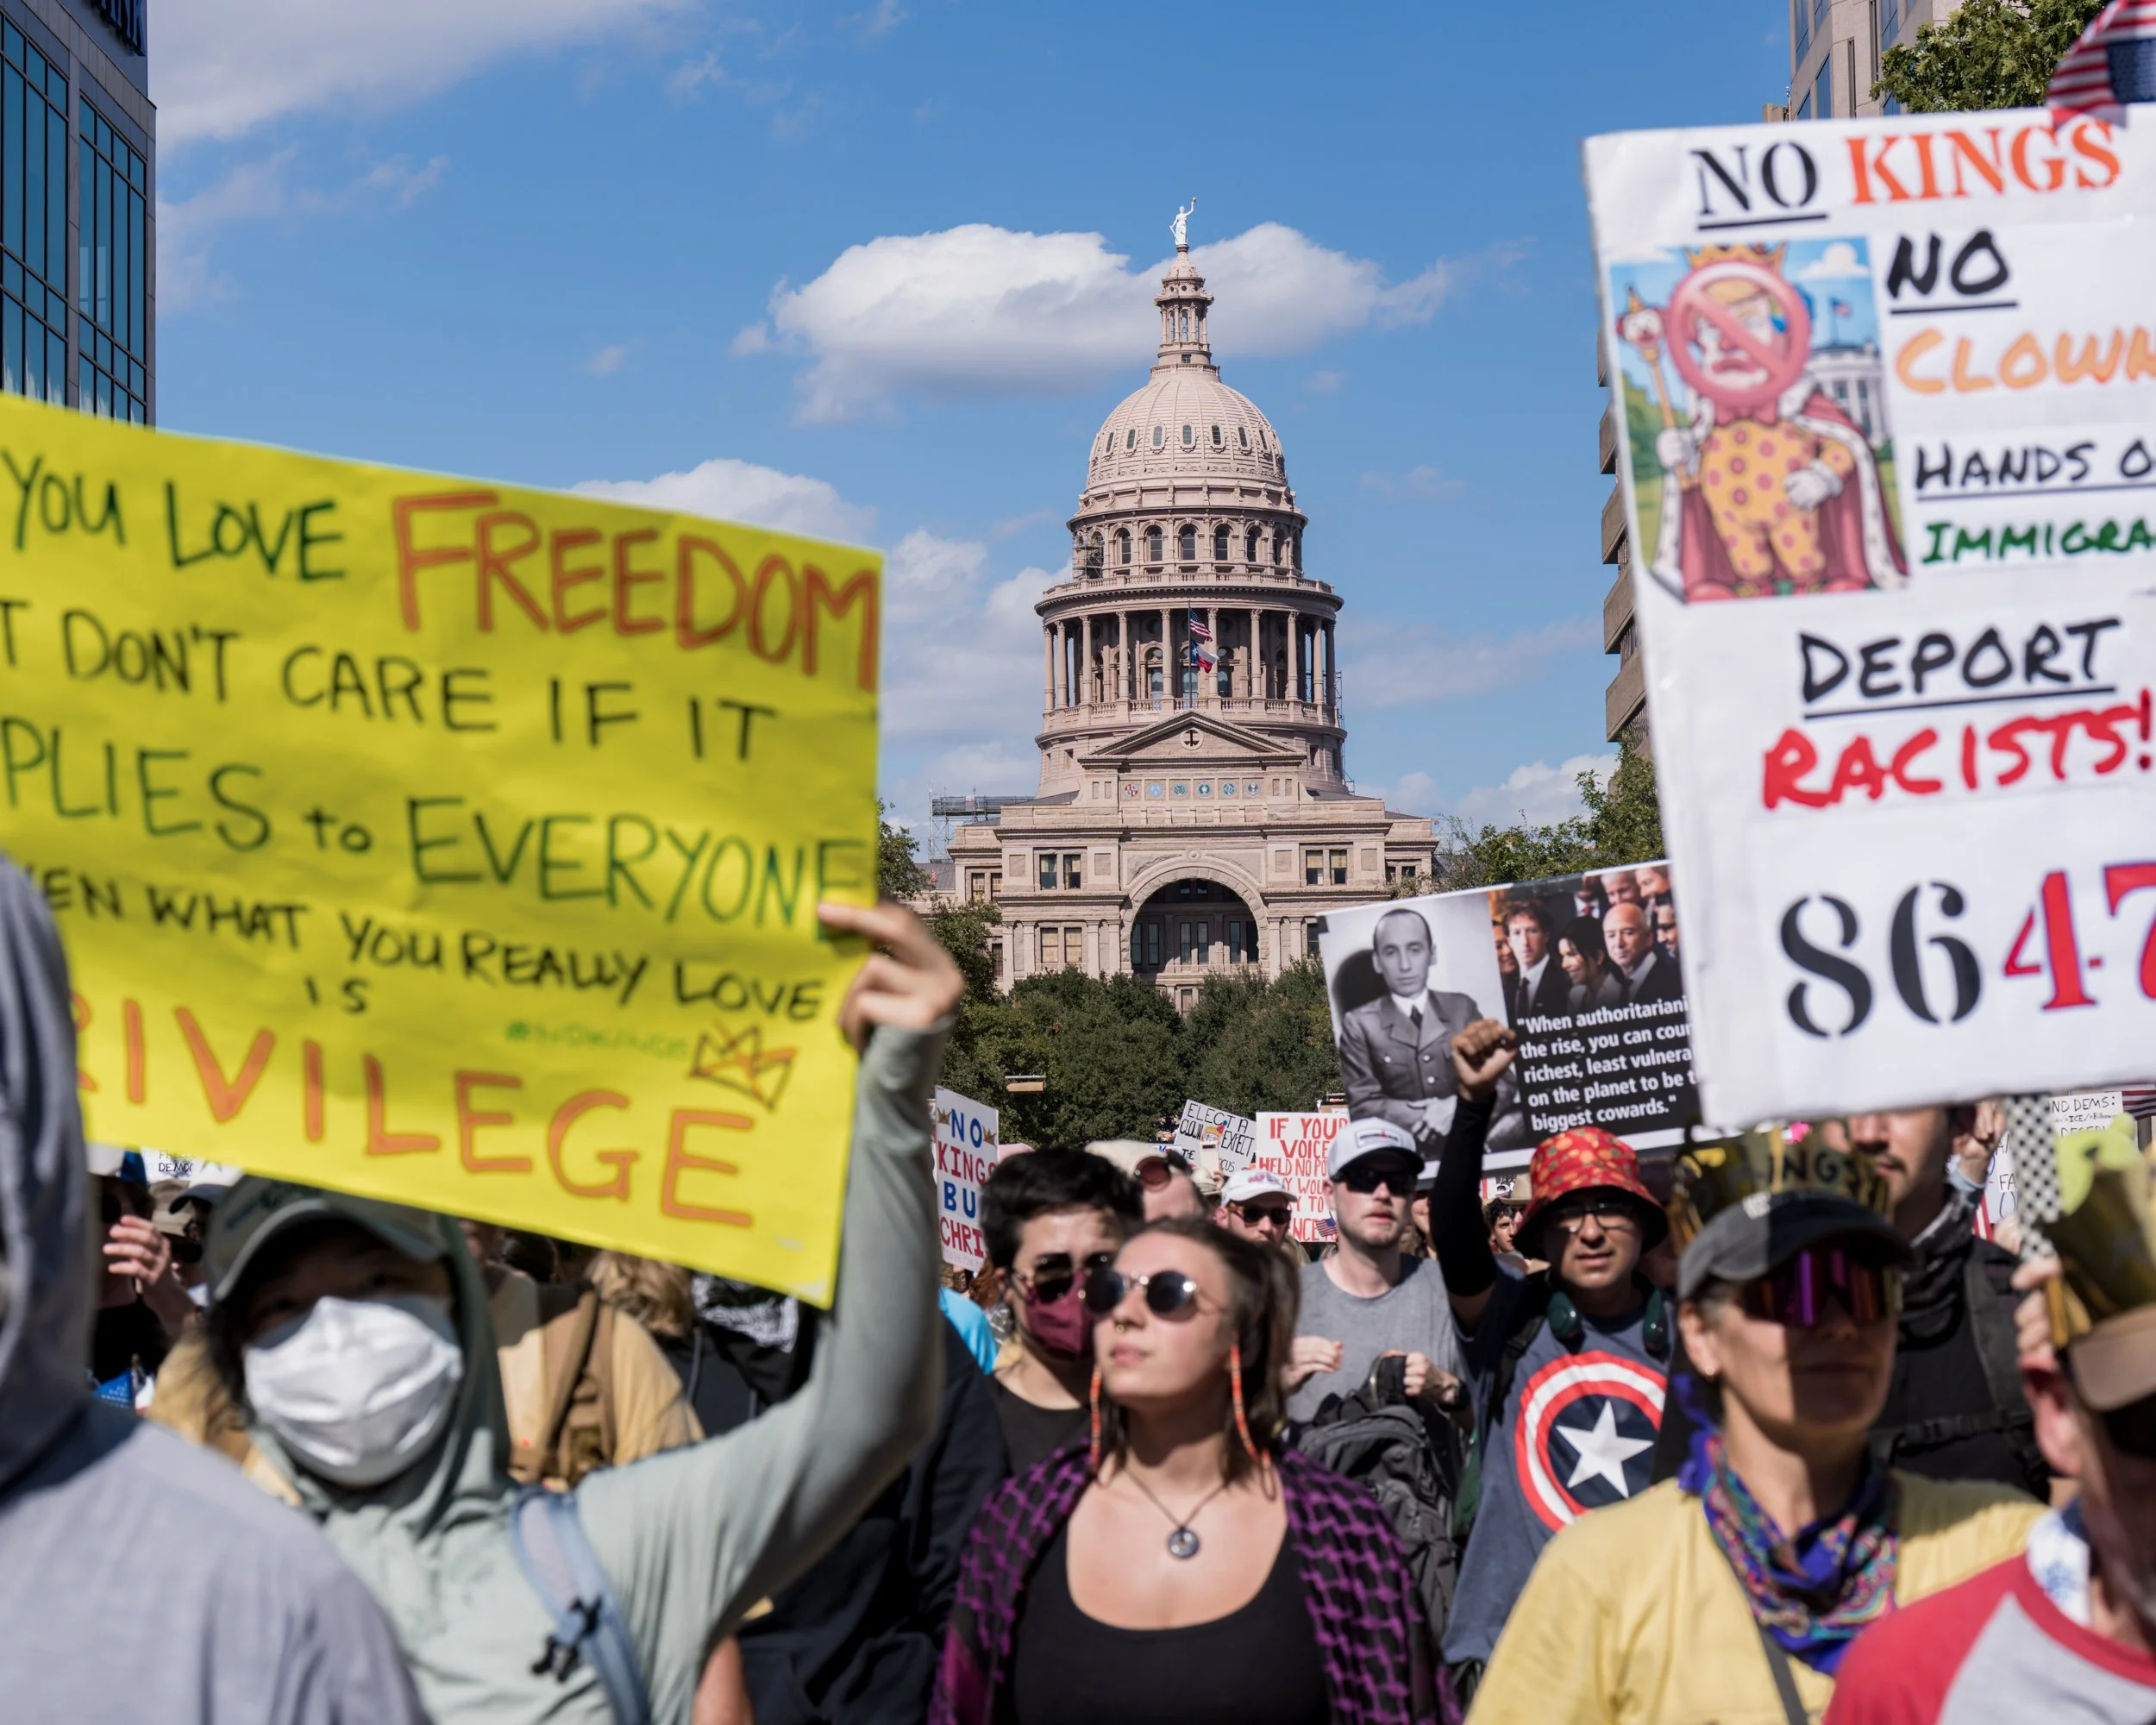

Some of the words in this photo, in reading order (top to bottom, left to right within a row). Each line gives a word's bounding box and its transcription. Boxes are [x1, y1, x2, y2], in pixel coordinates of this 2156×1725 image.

[1689, 140, 1818, 215] NO
[1846, 120, 2122, 204] KINGS
[1887, 230, 2009, 298] NO
[1915, 440, 2096, 489] HANDS
[0, 449, 126, 551] YOU
[166, 480, 347, 580] LOVE
[393, 492, 878, 693] FREEDOM
[1799, 618, 2120, 702] DEPORT
[64, 610, 241, 702] DON'T
[282, 646, 498, 731] CARE
[551, 677, 637, 745] IF
[689, 696, 777, 760] IT
[1762, 687, 2151, 811] RACISTS!
[2, 716, 271, 851] PLIES
[303, 806, 373, 852] to
[407, 797, 866, 942] EVERYONE
[29, 864, 122, 918] EN
[146, 887, 307, 949] WHAT
[342, 911, 442, 971] YOU
[461, 931, 649, 1007] REALLY
[674, 962, 822, 1020] LOVE
[304, 976, 369, 1013] IS
[1517, 1014, 1572, 1034] "When
[1520, 1042, 1547, 1059] the
[1551, 1038, 1585, 1054] rise,
[1588, 1034, 1620, 1053] you
[1623, 1029, 1651, 1044] can
[1524, 1064, 1583, 1083] richest,
[1586, 1057, 1627, 1074] least
[1630, 1048, 1693, 1066] vulnera
[1528, 1093, 1549, 1107] on
[1552, 1086, 1580, 1103] the
[1584, 1079, 1637, 1103] planet
[1640, 1077, 1658, 1090] to
[1662, 1072, 1683, 1088] be
[2074, 1096, 2115, 1111] DEMS:
[951, 1108, 982, 1148] NO
[1188, 1103, 1235, 1128] ELECT
[1238, 1120, 1248, 1133] A
[1269, 1118, 1288, 1138] IF
[1531, 1107, 1592, 1132] biggest
[1596, 1095, 1676, 1121] cowards."
[1182, 1149, 1195, 1160] THE
[1259, 1157, 1292, 1176] HELD
[1295, 1159, 1311, 1176] NO
[1280, 1140, 1330, 1158] VOICE
[1308, 1196, 1324, 1213] TO
